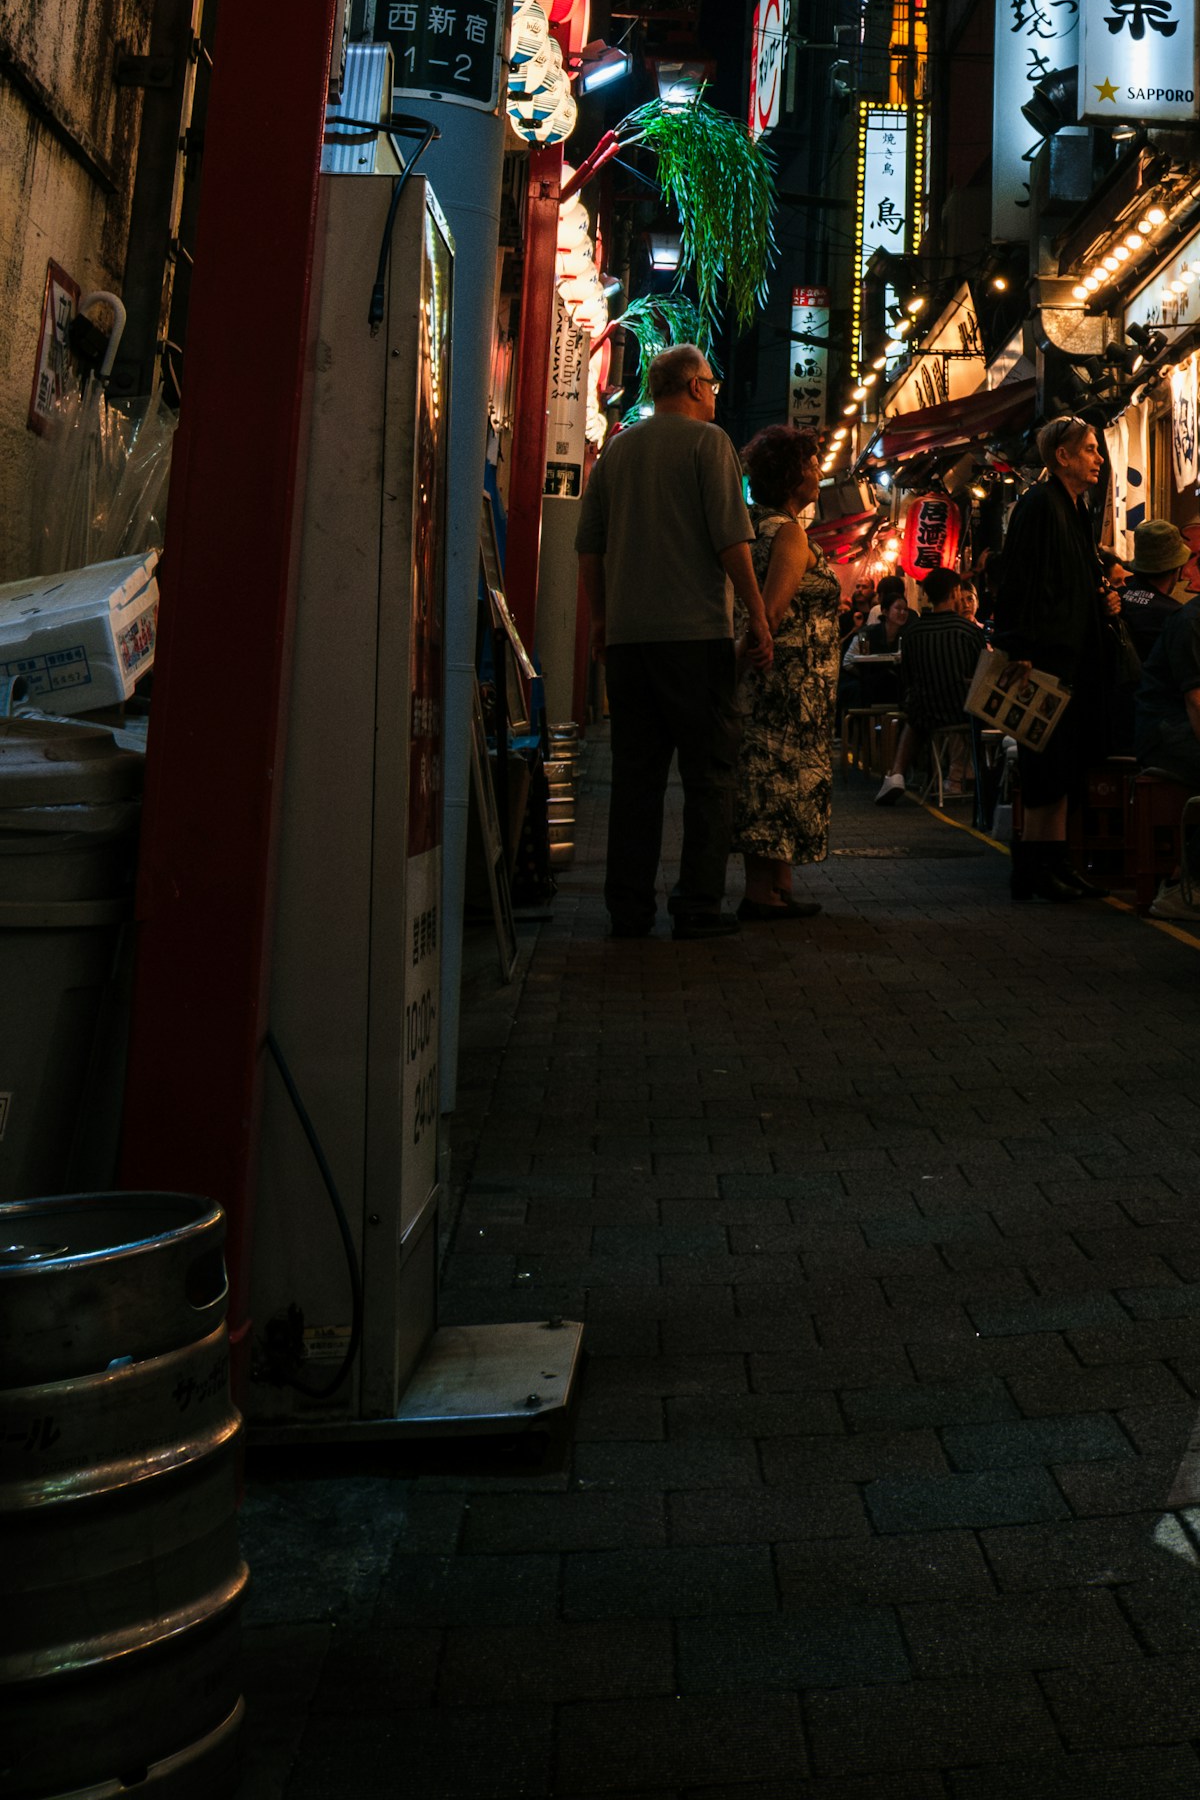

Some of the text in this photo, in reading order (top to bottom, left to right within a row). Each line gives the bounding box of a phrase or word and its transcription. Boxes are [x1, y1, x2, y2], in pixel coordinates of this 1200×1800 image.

[388, 3, 488, 45] 西新宿
[1127, 85, 1195, 105] SAPPORO
[882, 132, 896, 177] 焼き鳥
[914, 501, 948, 569] 居酒屋
